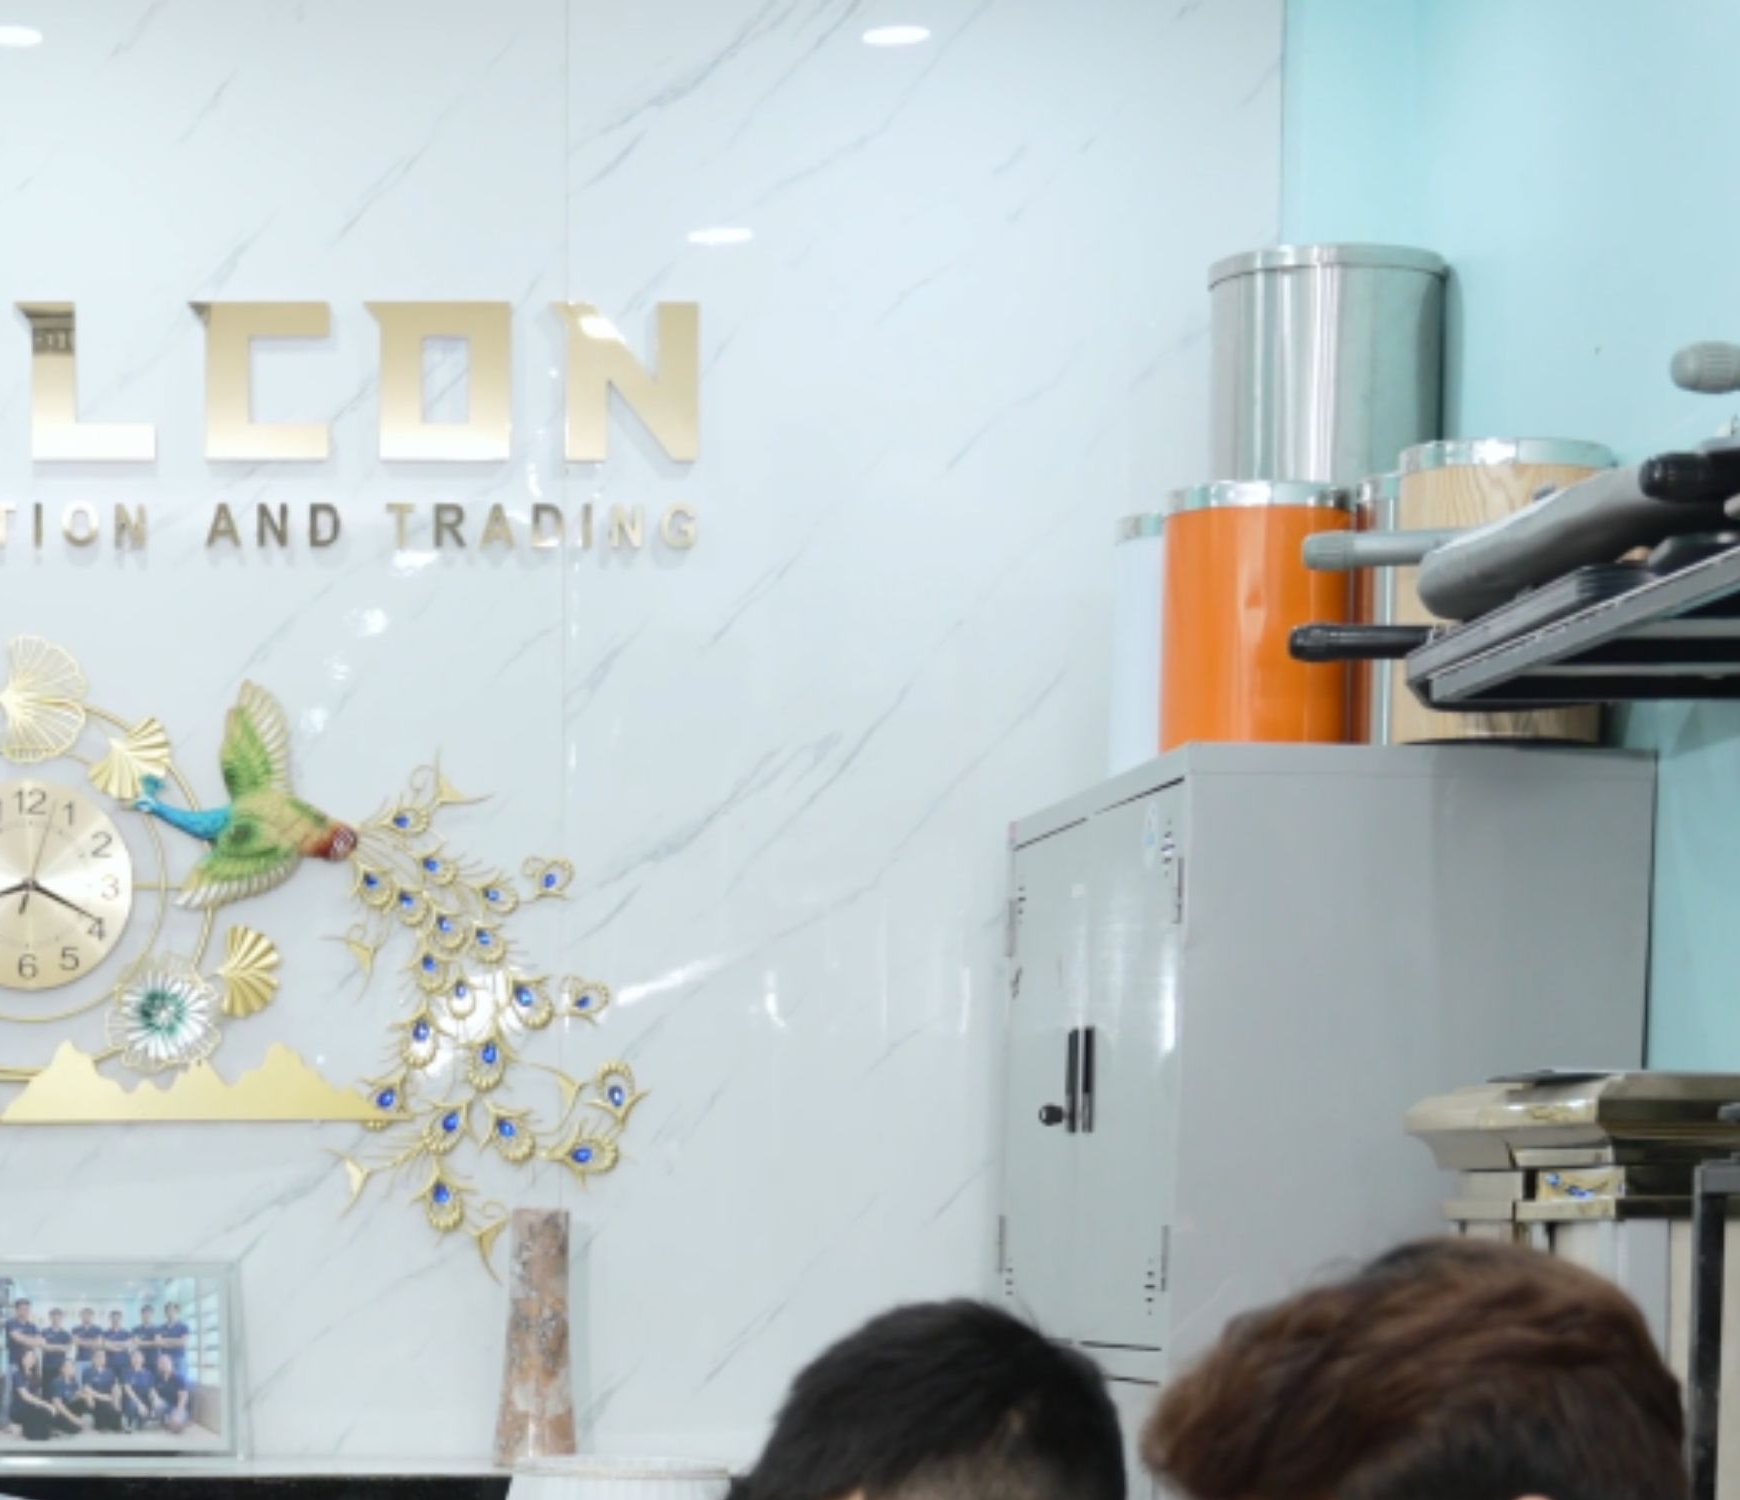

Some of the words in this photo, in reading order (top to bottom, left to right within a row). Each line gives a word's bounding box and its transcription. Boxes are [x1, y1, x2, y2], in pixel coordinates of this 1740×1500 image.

[206, 502, 341, 548] AND
[386, 502, 700, 548] TRADING
[13, 788, 47, 815] 12
[64, 801, 74, 826] 1
[91, 831, 113, 858] 2
[101, 874, 120, 900] 3
[87, 918, 106, 941] 4
[18, 953, 38, 980] 6
[59, 947, 80, 971] 5
